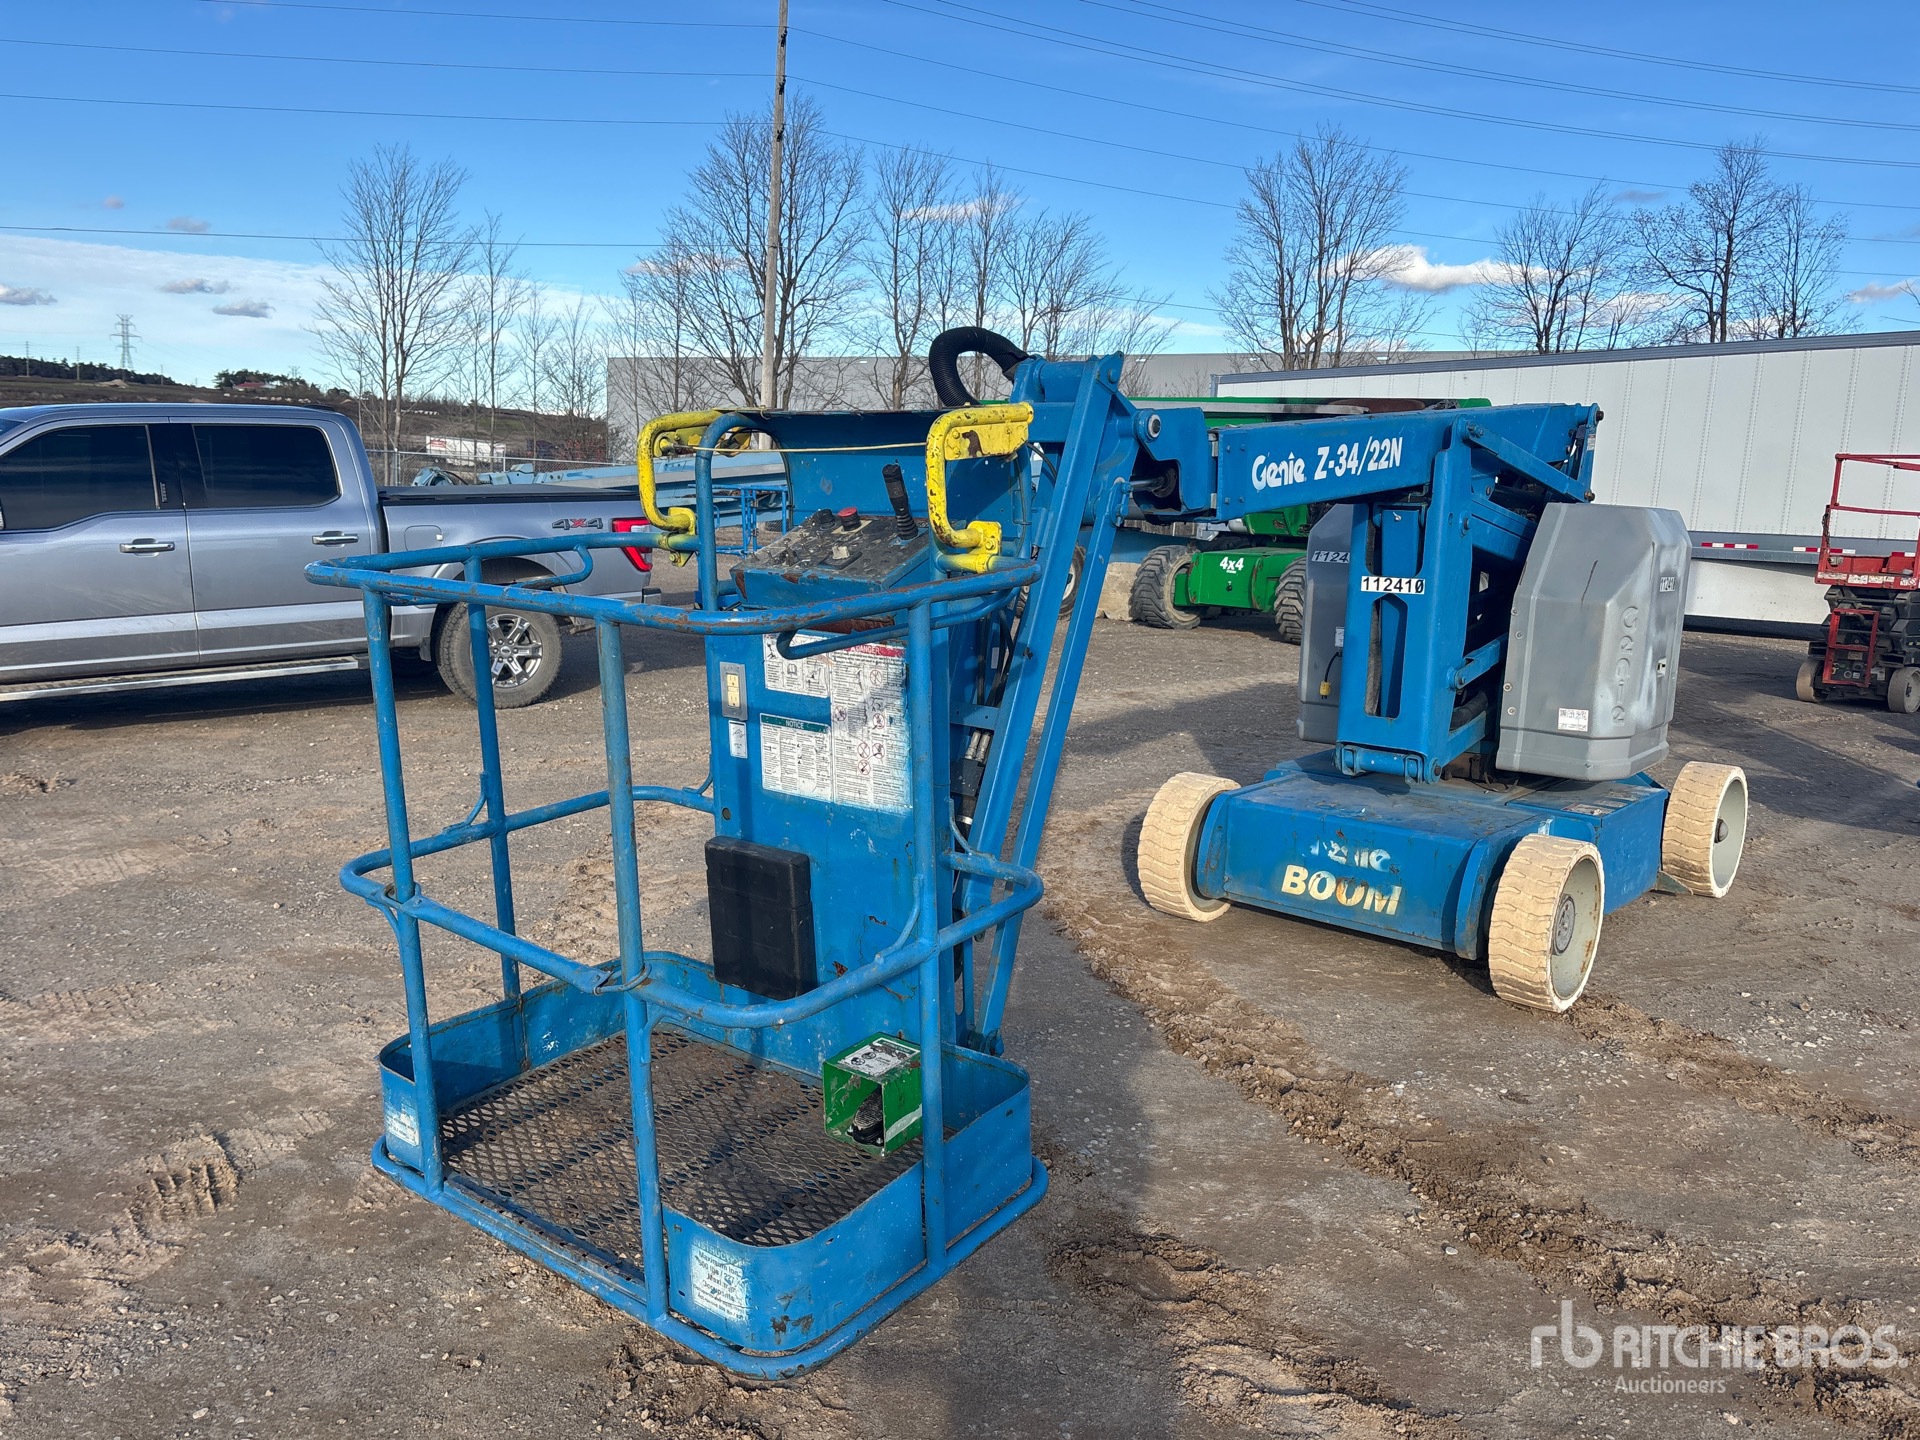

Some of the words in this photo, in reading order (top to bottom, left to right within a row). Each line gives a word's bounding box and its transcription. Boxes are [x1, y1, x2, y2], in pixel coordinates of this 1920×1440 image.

[1252, 452, 1305, 490] Genie
[1314, 436, 1403, 480] Z-34/22N
[1220, 556, 1244, 571] 4x4
[1314, 551, 1349, 562] 1124
[1363, 577, 1424, 594] 112410
[856, 645, 880, 654] DANGER
[785, 720, 805, 730] NOTICE
[1281, 864, 1402, 915] BOOM
